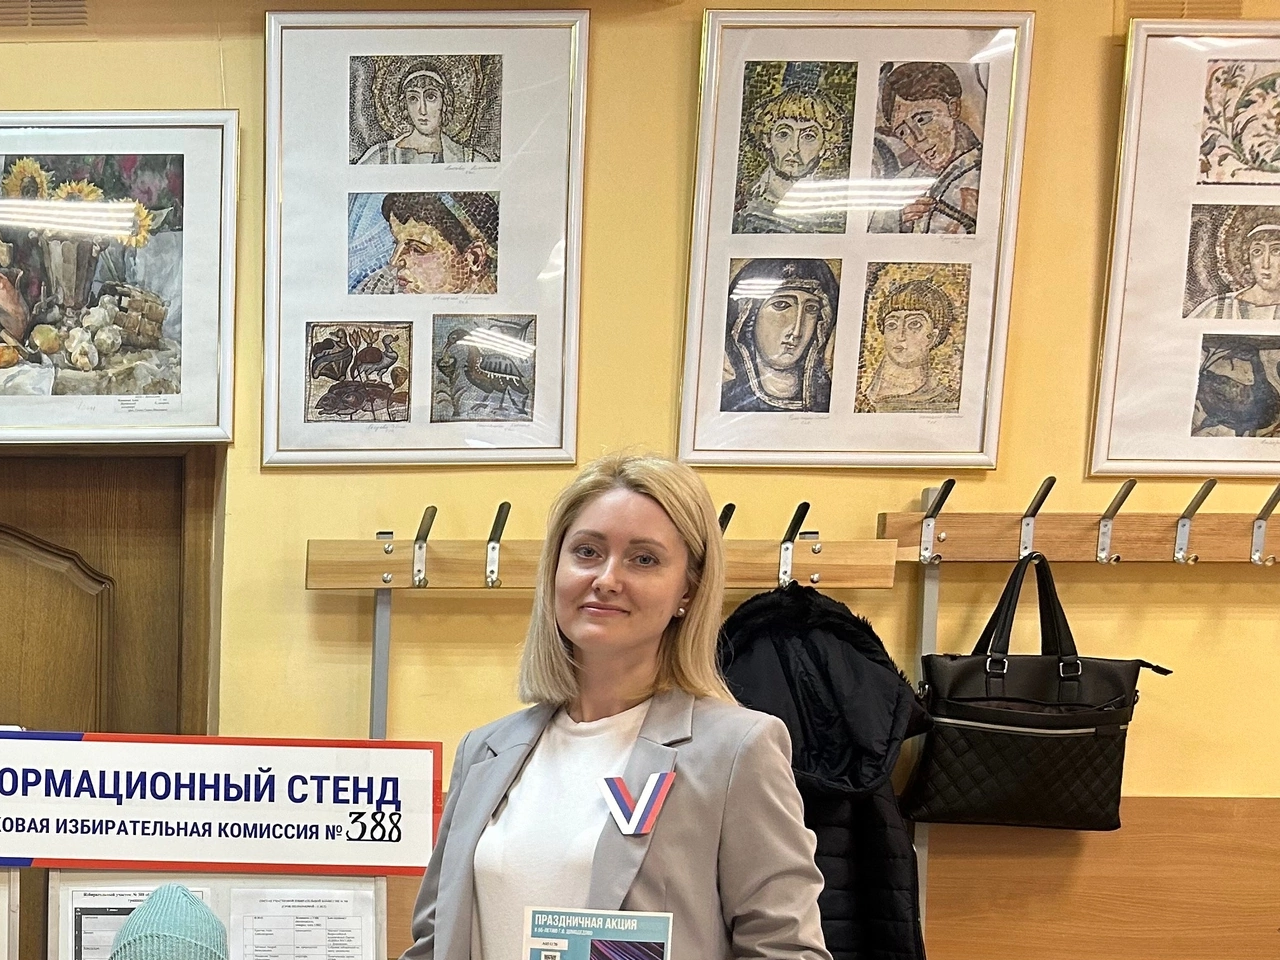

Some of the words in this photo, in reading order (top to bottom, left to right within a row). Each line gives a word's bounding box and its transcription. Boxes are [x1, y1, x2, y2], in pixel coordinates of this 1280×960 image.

[287, 774, 402, 812] СТЕНД
[56, 818, 212, 837] ИЗБИРАТЕЛЬНАЯ
[218, 822, 319, 840] КОМИССИЯ
[325, 824, 343, 840] №
[346, 811, 402, 843] 388
[535, 914, 603, 929] ПРАЗДНИЧНАЯ
[605, 918, 638, 931] АКЦИЯ
